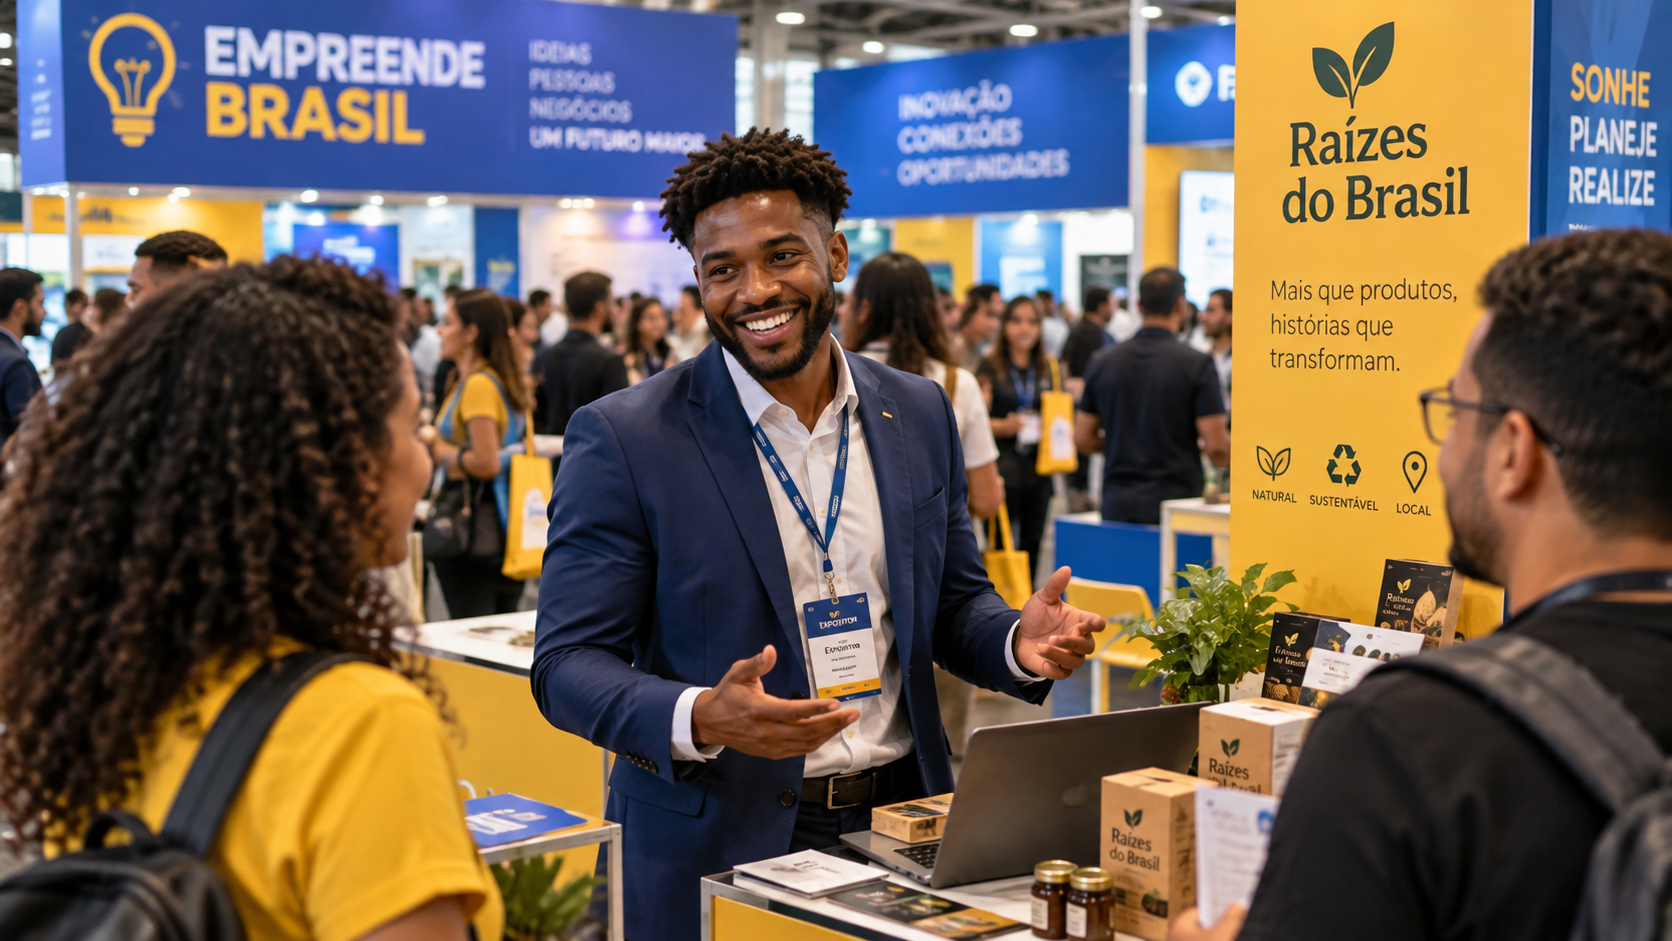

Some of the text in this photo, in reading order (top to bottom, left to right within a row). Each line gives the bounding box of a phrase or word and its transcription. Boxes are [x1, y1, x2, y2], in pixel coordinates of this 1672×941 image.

[205, 25, 486, 89] EMPREENDE
[529, 39, 593, 66] IDEIAS
[529, 67, 616, 95] PESSOAS
[898, 78, 1013, 120] INOVAÇÃO
[1570, 62, 1651, 108] SONHE
[206, 81, 426, 145] BRASIL
[529, 94, 633, 123] NEGÓCIOS
[529, 125, 563, 150] UM
[564, 126, 643, 153] FUTURO
[897, 114, 1023, 154] CONEXÕES
[1290, 115, 1428, 167] Raízes
[1570, 115, 1658, 158] PLANEJE
[896, 148, 1071, 187] OPORTUNIDADES
[1568, 166, 1656, 207] REALIZE
[1282, 166, 1470, 224] do Brasil
[1271, 278, 1457, 306] Mais que produtos,
[1271, 313, 1394, 341] histórias que
[1270, 347, 1400, 372] transformam.
[1252, 489, 1432, 517] NATURAL SUSTENTÁVEL LOCAL
[1109, 846, 1160, 872] do Brasil
